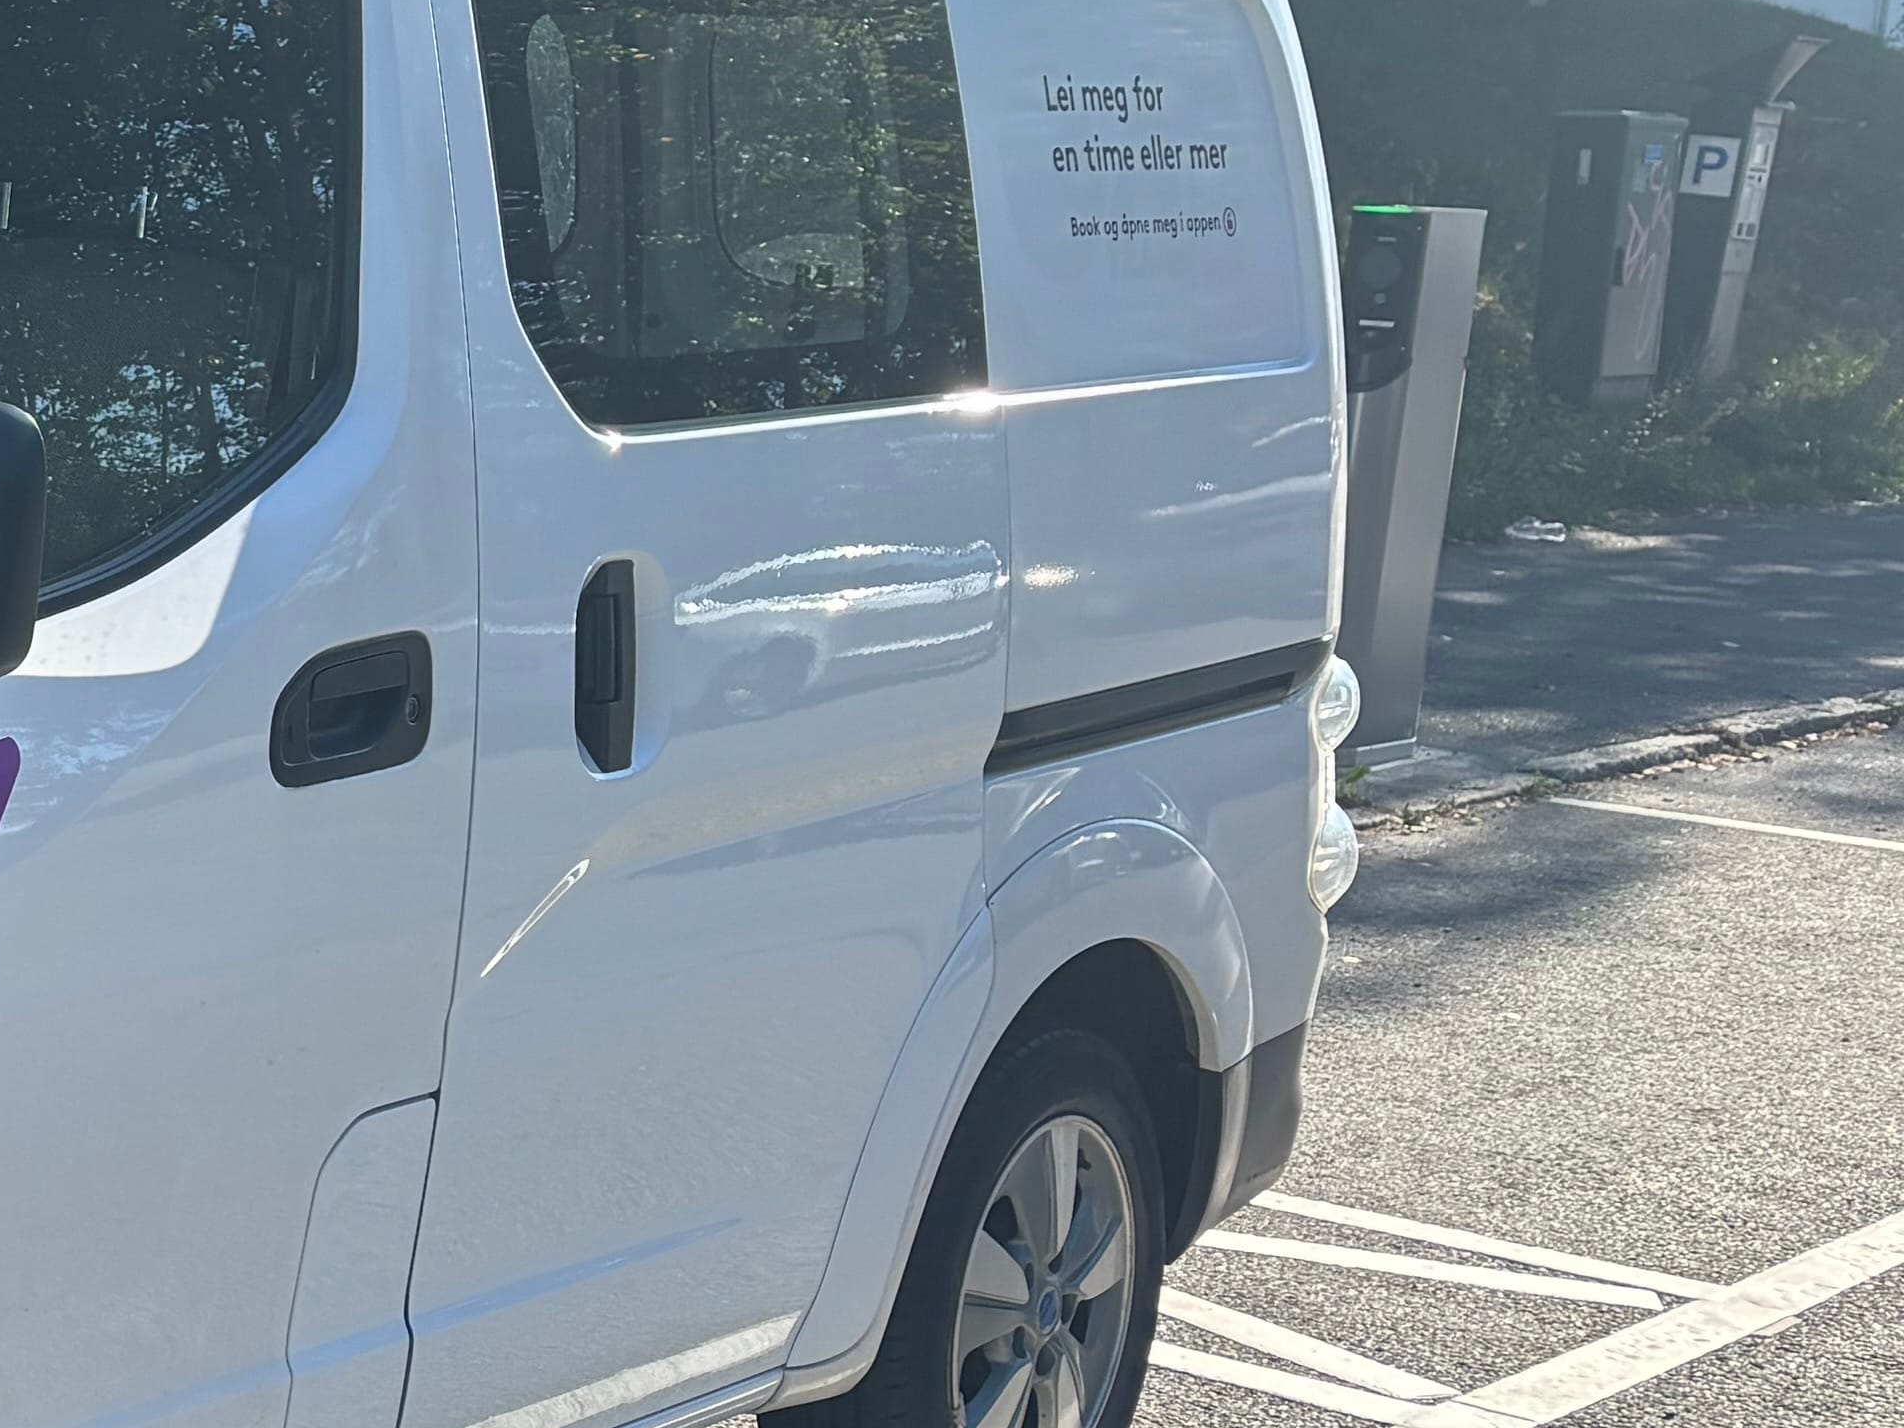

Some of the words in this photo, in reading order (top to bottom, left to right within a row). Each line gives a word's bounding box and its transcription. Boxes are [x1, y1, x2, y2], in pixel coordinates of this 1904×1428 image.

[1043, 74, 1075, 112] Lei
[1081, 83, 1128, 123] meg
[1132, 75, 1164, 112] for
[1052, 145, 1079, 172] en
[1083, 134, 1135, 172] time
[1141, 134, 1183, 170] eller
[1189, 142, 1228, 170] mer
[1692, 145, 1729, 185] P
[1070, 216, 1101, 237] Book
[1104, 221, 1119, 241] og
[1122, 213, 1150, 240] åpne
[1153, 219, 1178, 239] meg
[1179, 212, 1185, 232] i
